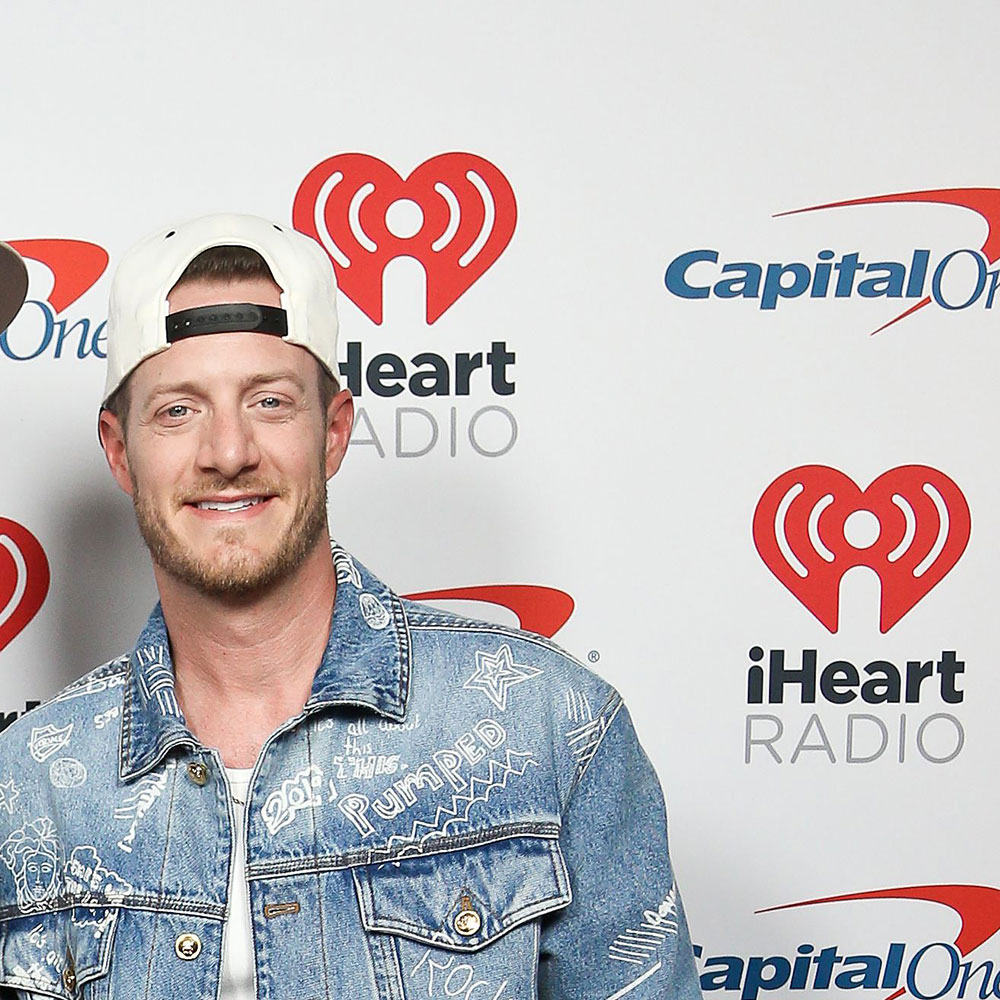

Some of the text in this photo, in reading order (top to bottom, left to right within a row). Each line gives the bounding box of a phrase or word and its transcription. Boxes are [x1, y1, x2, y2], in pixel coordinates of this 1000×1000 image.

[748, 646, 965, 705] iHeart
[744, 712, 965, 765] RADIO
[692, 942, 1000, 1000] apitalOn
